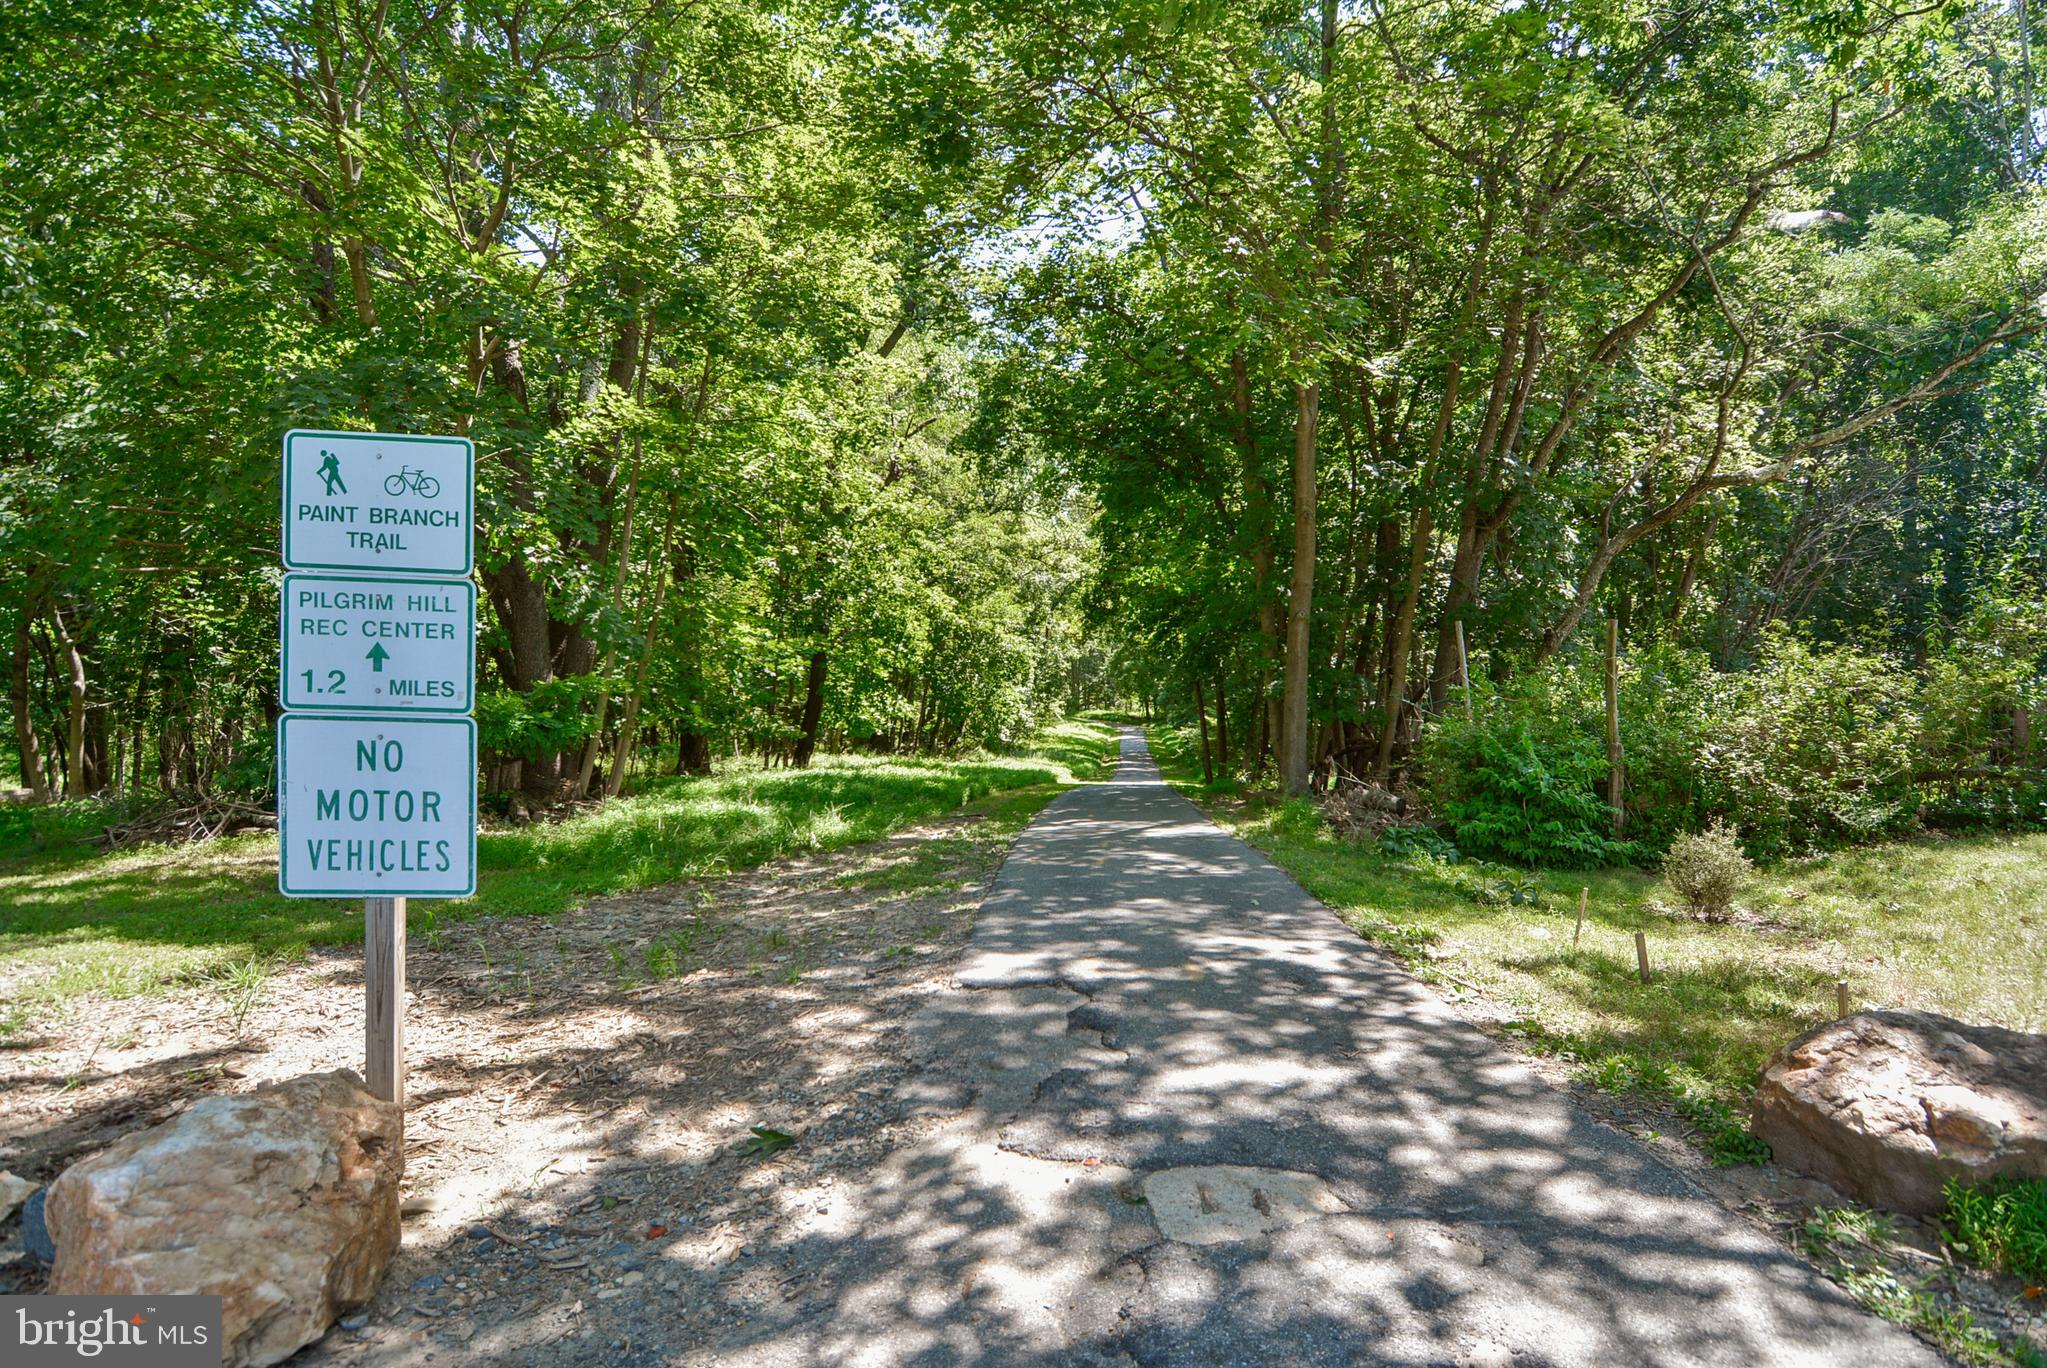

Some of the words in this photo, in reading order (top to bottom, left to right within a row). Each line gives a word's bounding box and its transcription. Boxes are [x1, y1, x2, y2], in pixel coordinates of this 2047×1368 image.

[298, 504, 358, 523] PAINT
[369, 507, 459, 527] BRANCH
[346, 531, 407, 550] TRAIL
[299, 591, 393, 611] PILGRIM
[408, 595, 456, 613] HILL
[301, 618, 348, 636] REC
[362, 620, 455, 639] CENTER
[301, 669, 346, 694] 1.2
[389, 679, 455, 697] MILES
[357, 740, 404, 773] NO
[317, 789, 441, 822] MOTOR
[307, 839, 450, 872] VEHICLES
